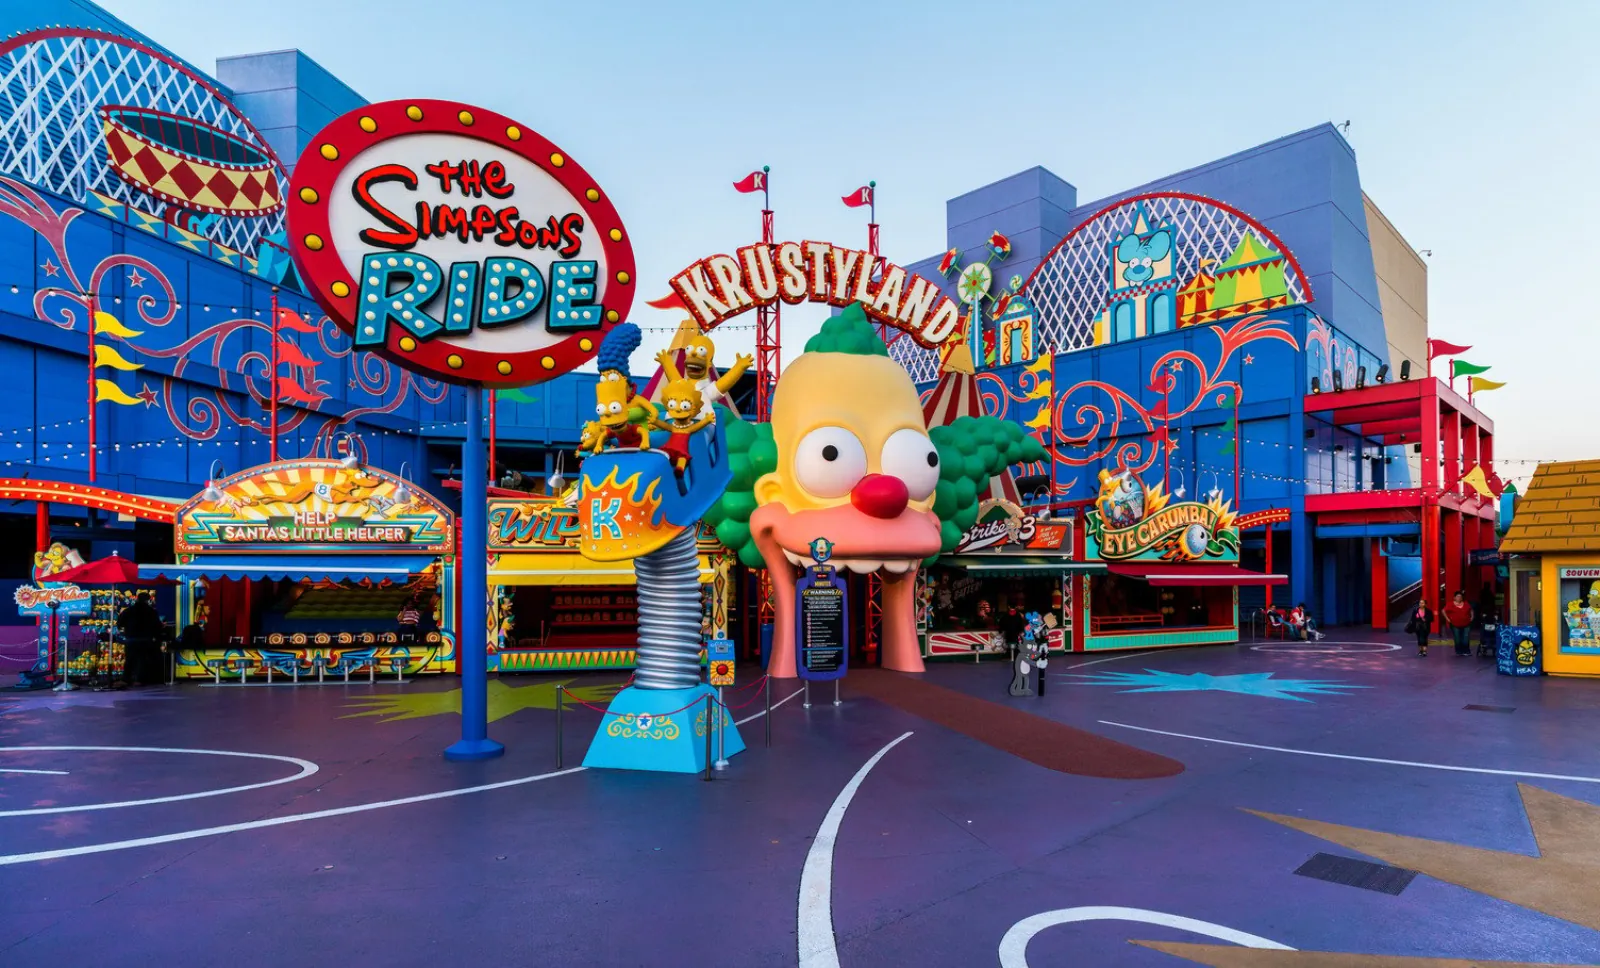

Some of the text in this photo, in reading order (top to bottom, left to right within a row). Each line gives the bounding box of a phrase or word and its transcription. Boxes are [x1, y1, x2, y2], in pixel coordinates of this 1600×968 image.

[753, 173, 763, 189] K
[861, 188, 870, 202] K
[352, 163, 584, 259] SIMPSONS
[352, 250, 604, 352] RIDE
[671, 240, 961, 347] KRUSTYLAND
[318, 484, 328, 495] 8
[293, 511, 338, 526] HELP
[591, 498, 622, 539] K
[1019, 516, 1035, 540] 3
[224, 527, 406, 541] SANTA'S LITTLE HELPER
[1103, 506, 1214, 554] EYE CARUMBA!
[1566, 569, 1600, 577] SOUVEN
